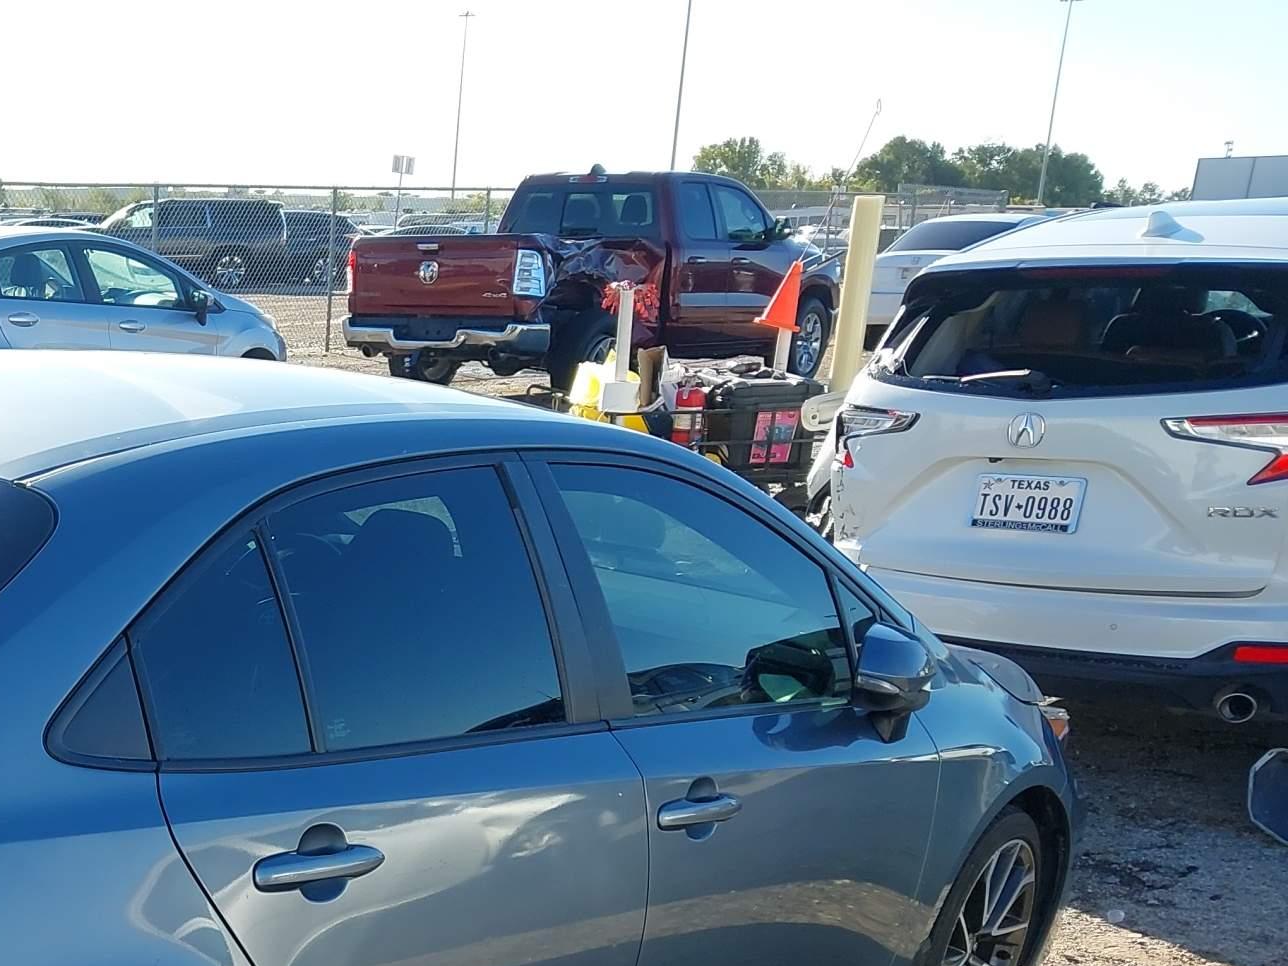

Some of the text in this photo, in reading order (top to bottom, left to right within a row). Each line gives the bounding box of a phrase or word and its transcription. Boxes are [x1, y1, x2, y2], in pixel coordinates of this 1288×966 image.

[1010, 479, 1050, 491] TEXAS
[1208, 506, 1280, 518] RDX
[976, 519, 1022, 529] STERLING
